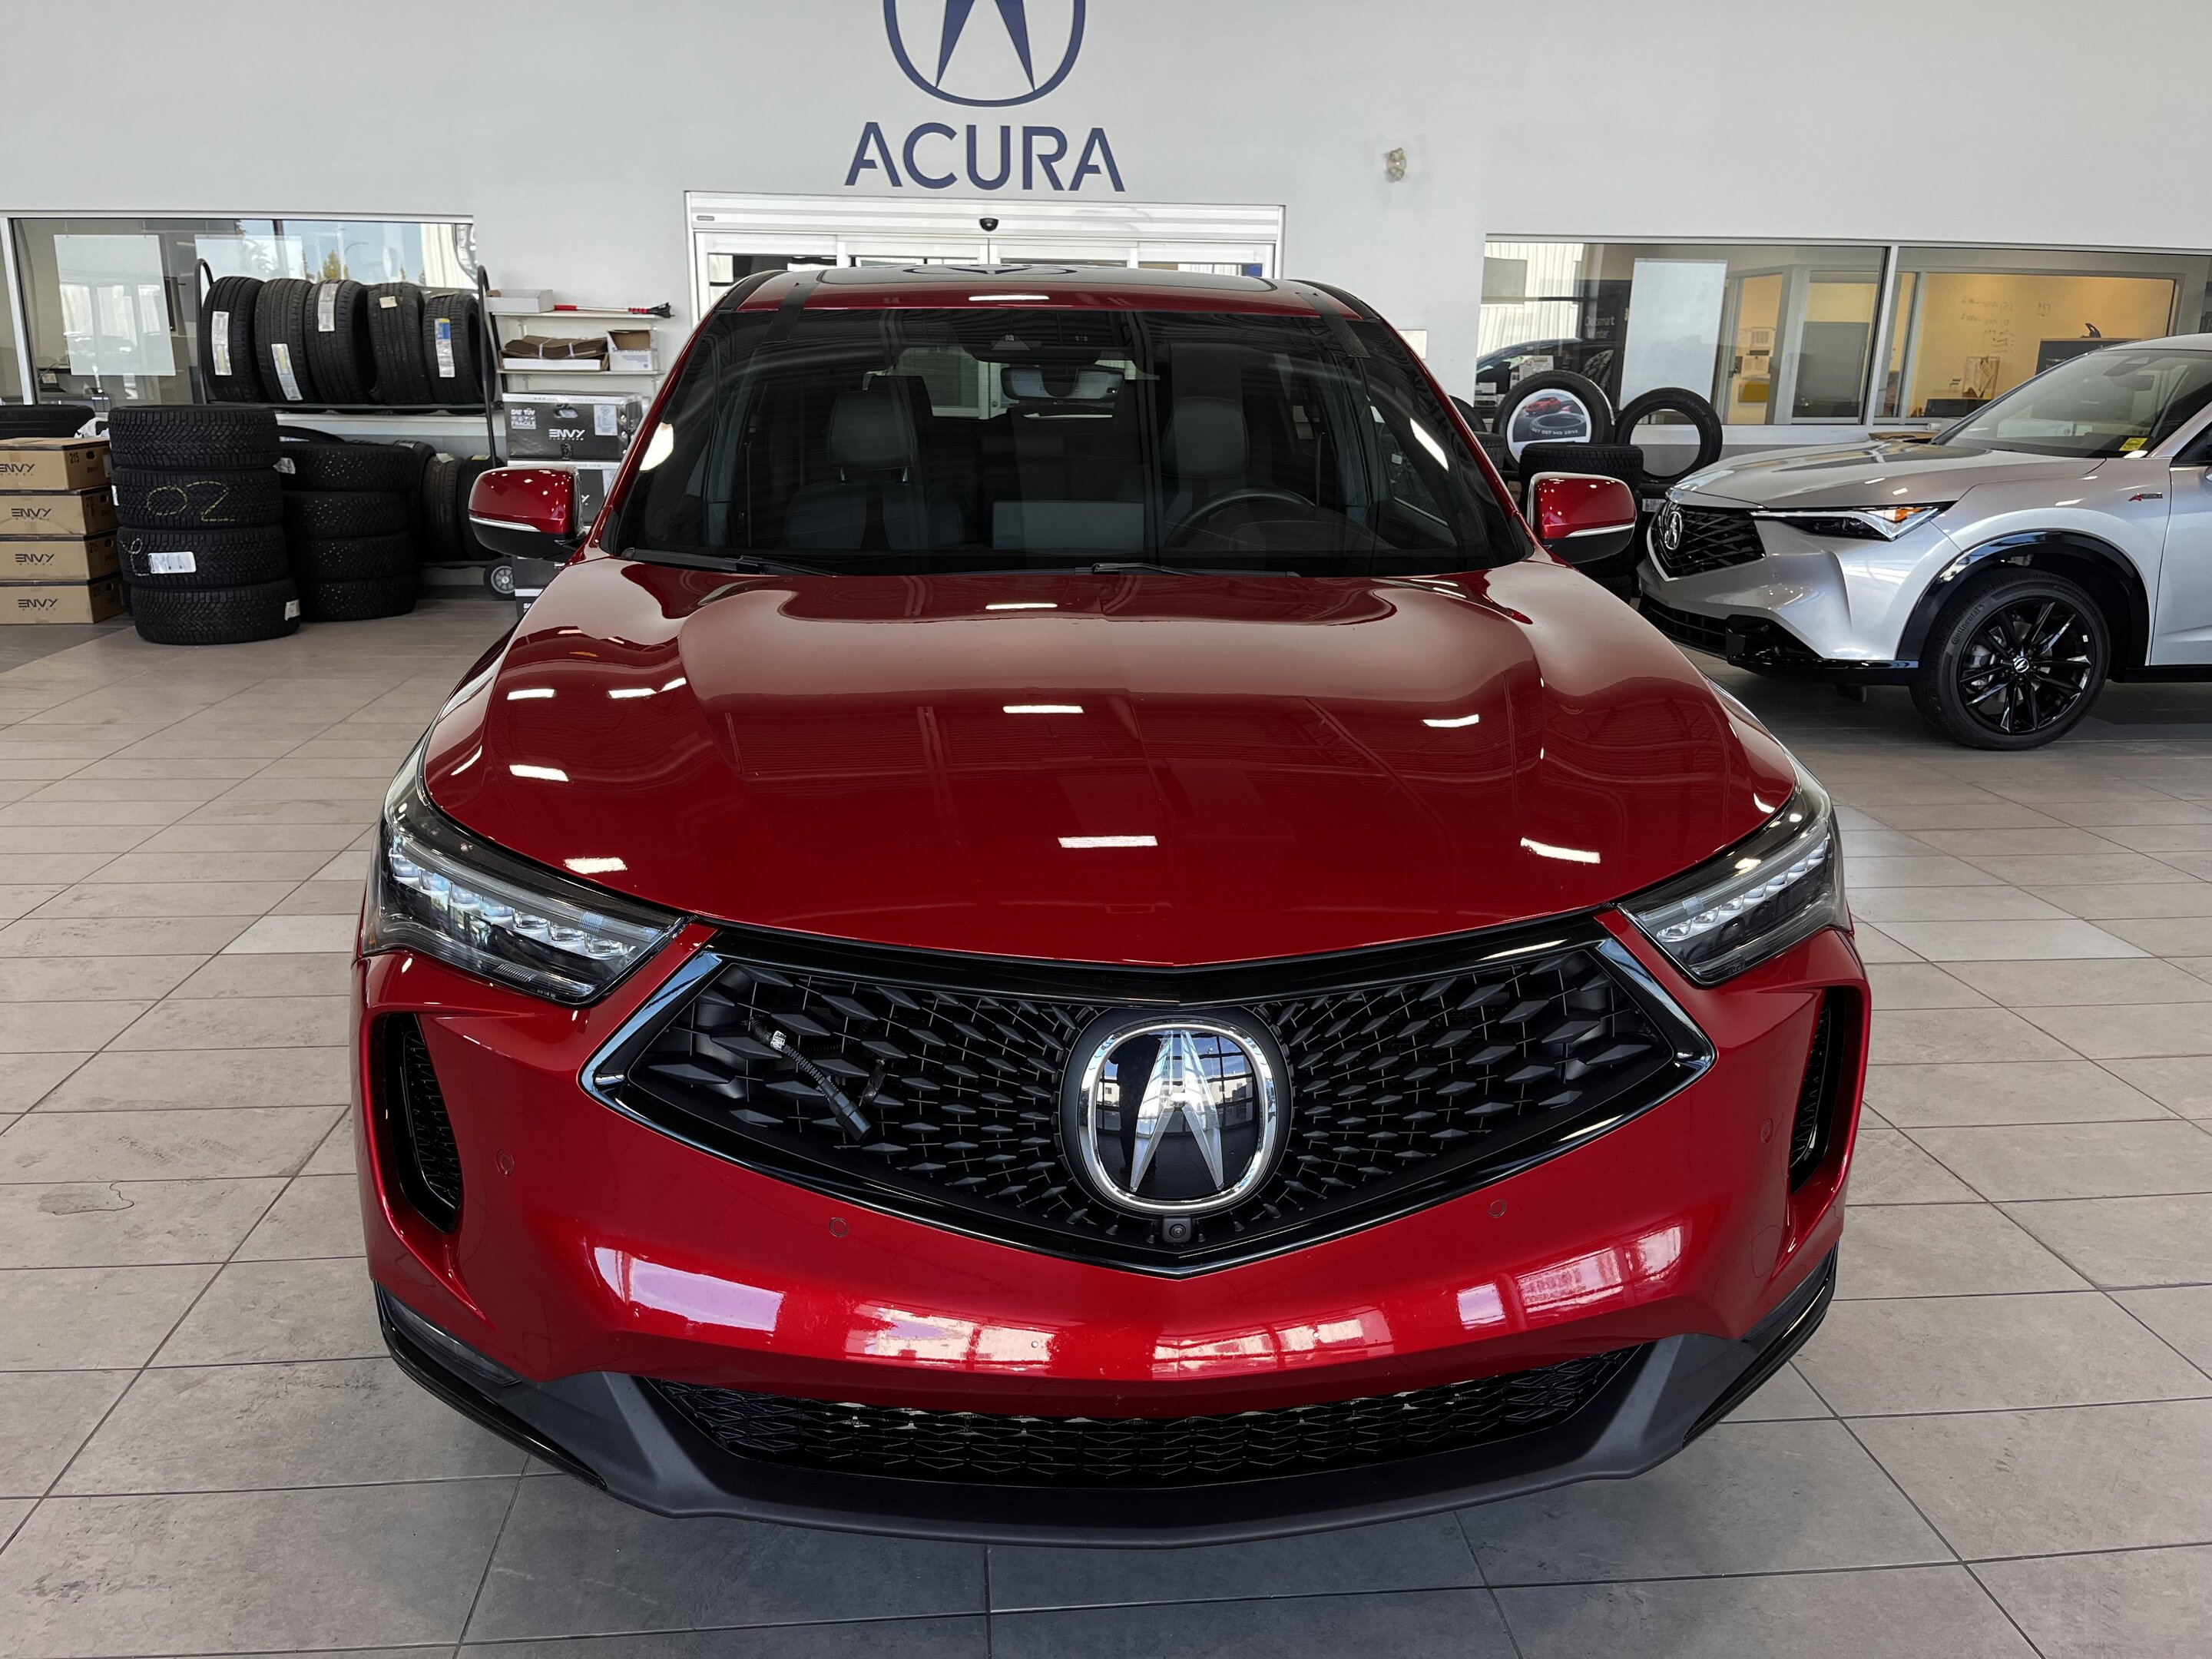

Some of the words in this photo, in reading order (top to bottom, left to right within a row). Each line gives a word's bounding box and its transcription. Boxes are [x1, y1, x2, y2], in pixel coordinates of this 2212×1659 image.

[845, 121, 1126, 192] ACURA
[548, 429, 586, 438] ENVY
[0, 463, 35, 472] ENVY
[11, 508, 52, 517] ENVY
[15, 553, 55, 562] ENVY
[17, 598, 58, 608] ENVY
